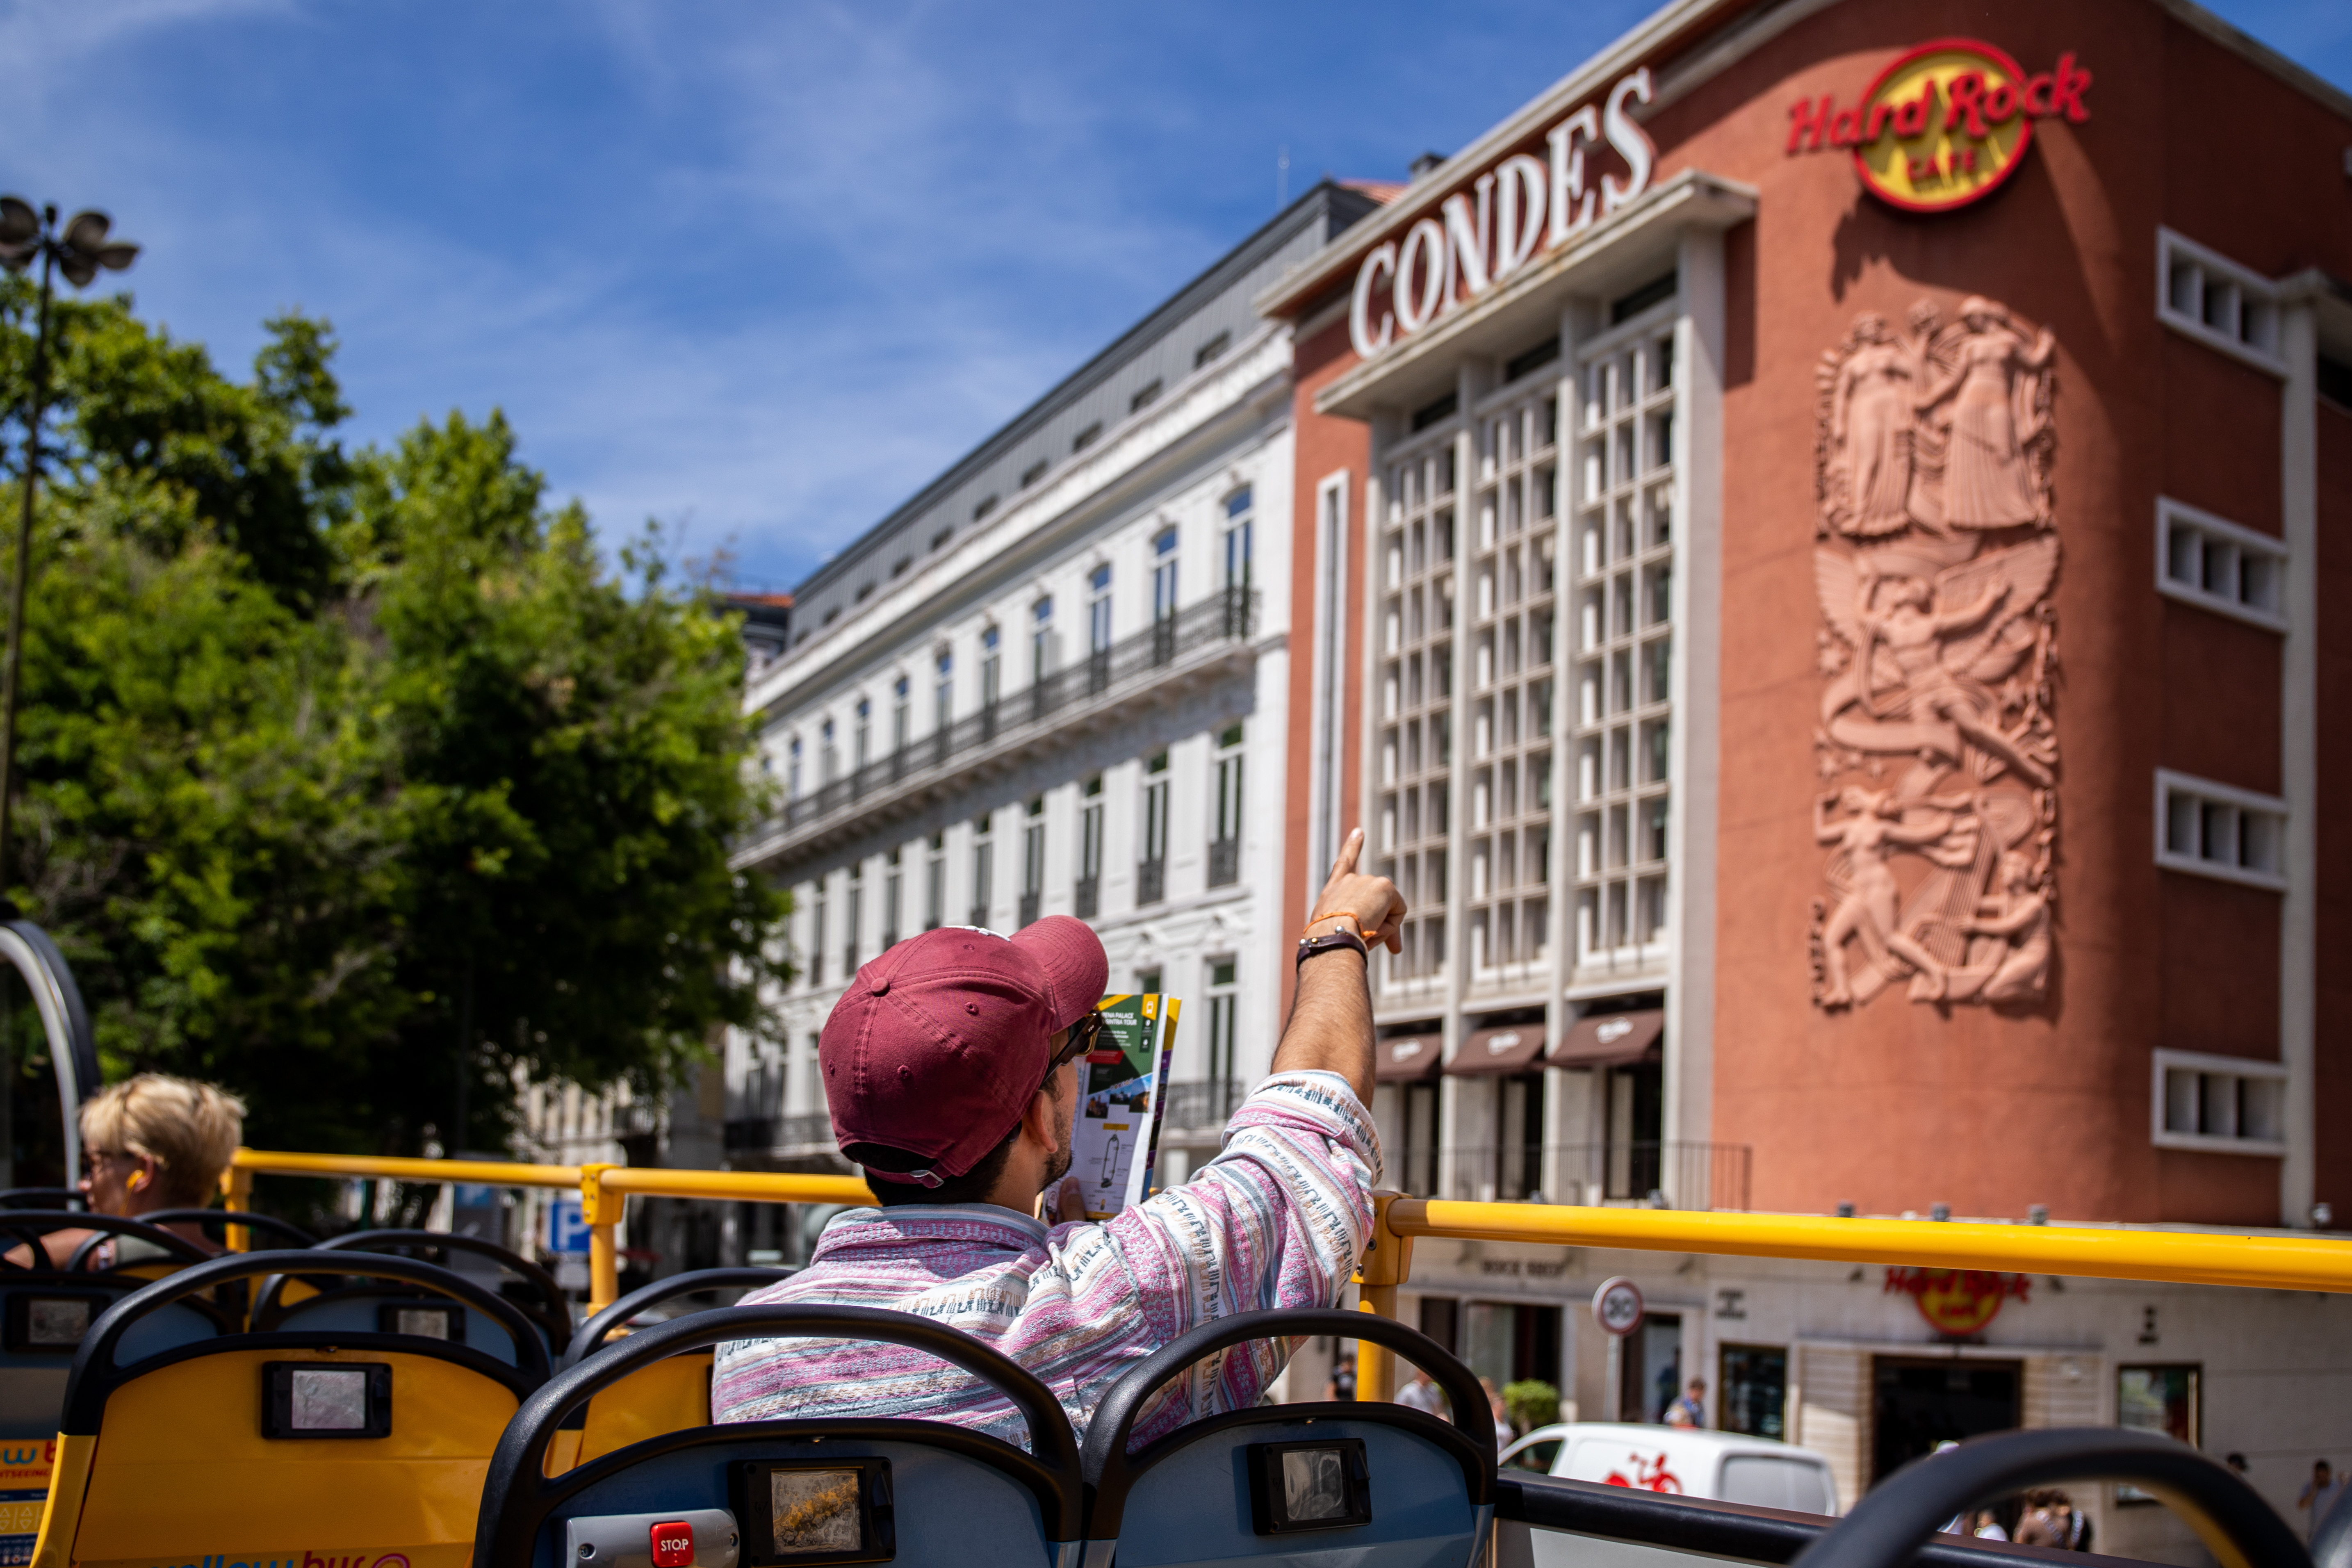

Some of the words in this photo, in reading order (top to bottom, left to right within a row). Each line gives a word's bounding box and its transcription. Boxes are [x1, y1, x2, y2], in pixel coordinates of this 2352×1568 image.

[1785, 79, 1935, 155] Hard
[1945, 50, 2092, 140] Rock
[1349, 66, 1654, 360] CONDES
[558, 1205, 588, 1249] P
[0, 1448, 37, 1465] w
[661, 1538, 689, 1552] STOP
